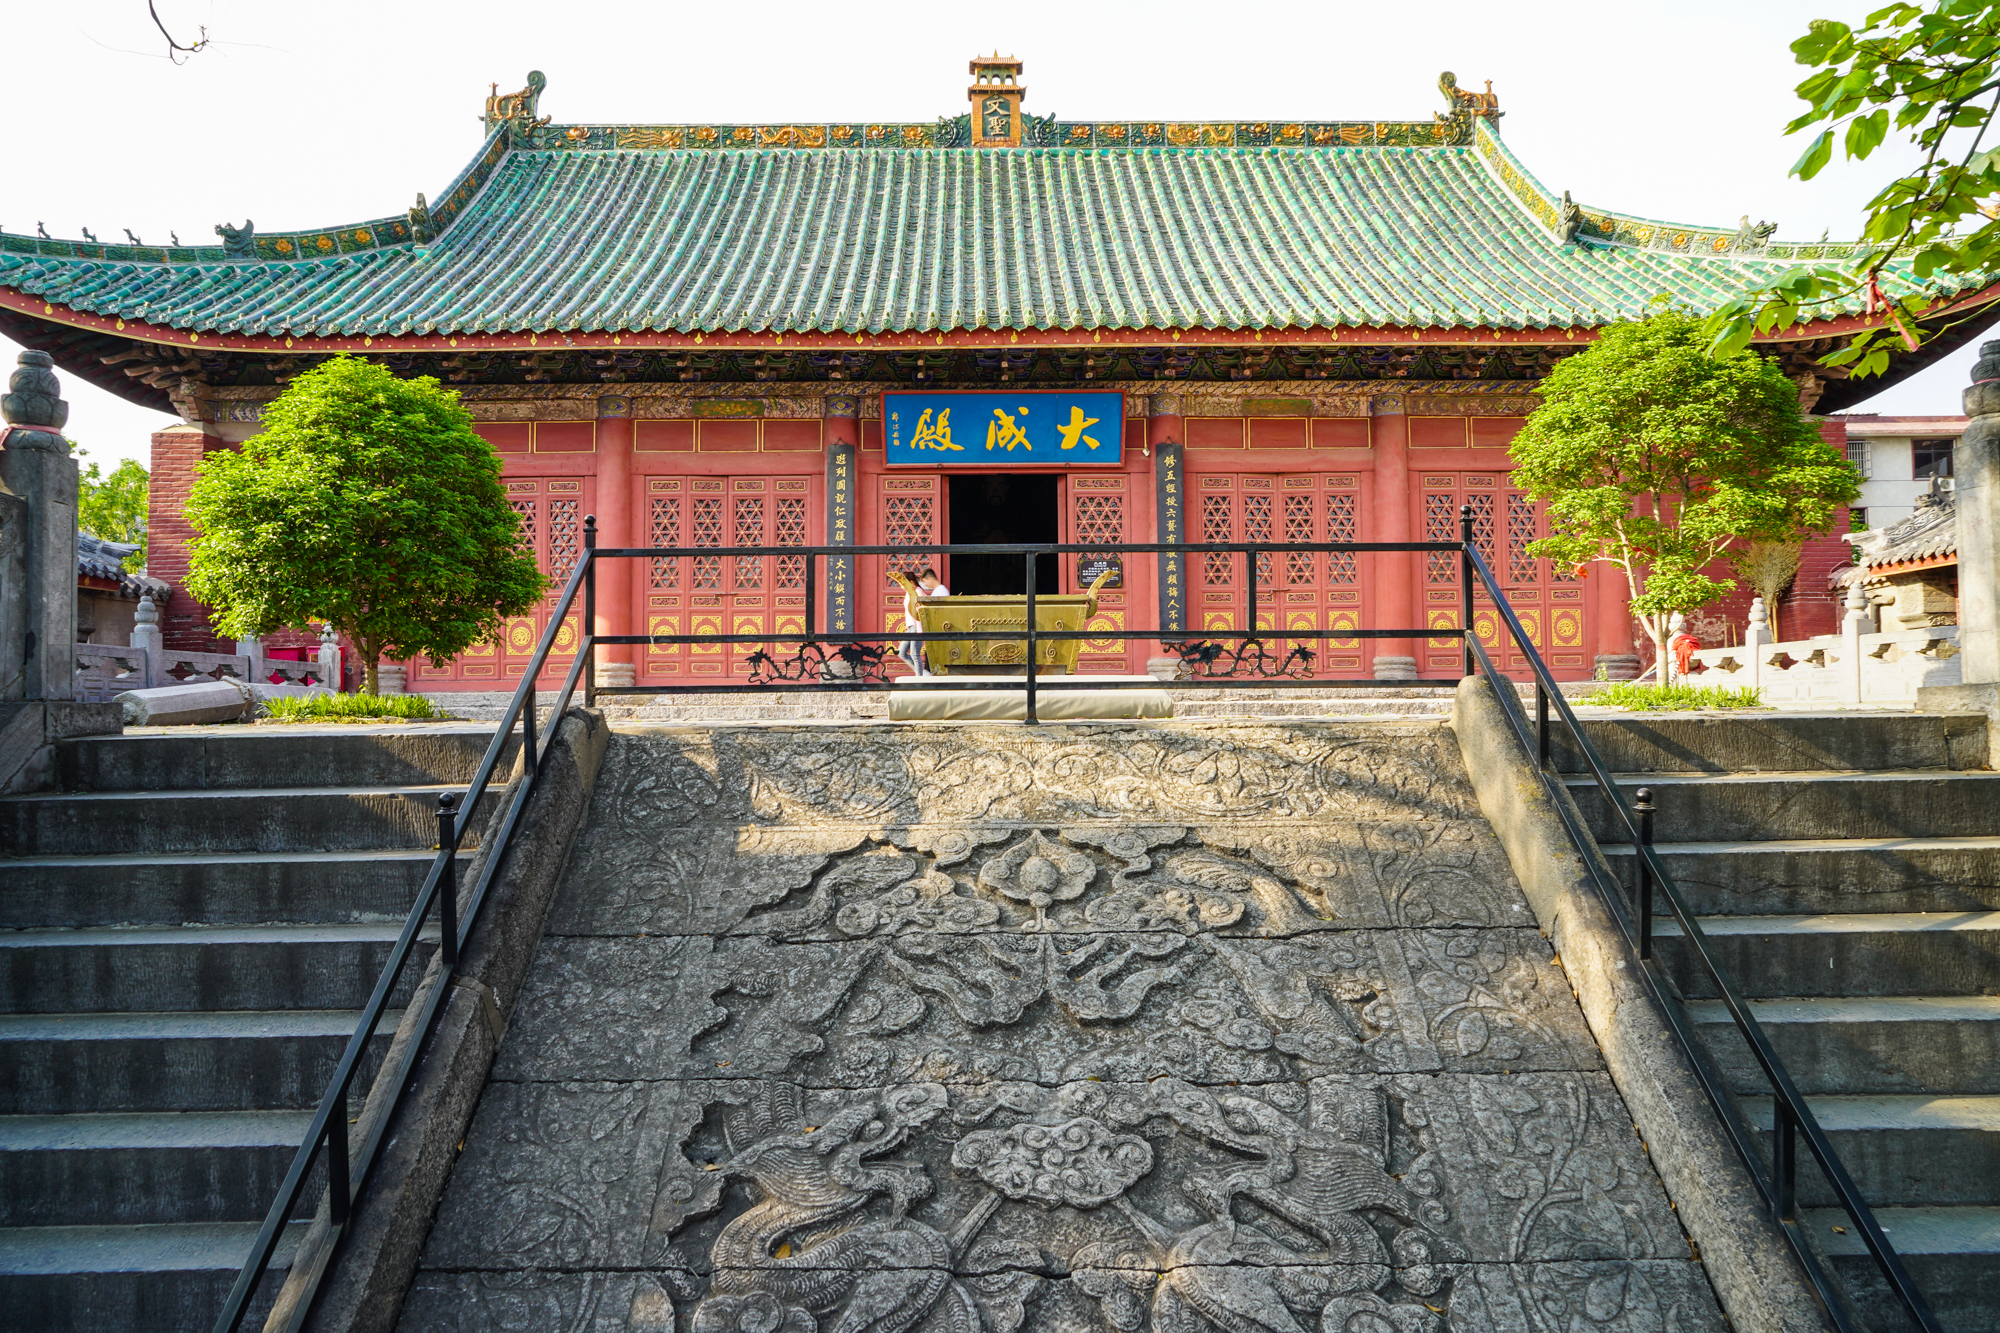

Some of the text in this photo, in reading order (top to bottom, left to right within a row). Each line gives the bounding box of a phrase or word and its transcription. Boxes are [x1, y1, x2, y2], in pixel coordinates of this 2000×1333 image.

[984, 95, 1010, 136] 文聖
[910, 406, 1101, 451] 大成殿
[834, 453, 847, 630] 遊列國說仁政疆大小鍥而不捨
